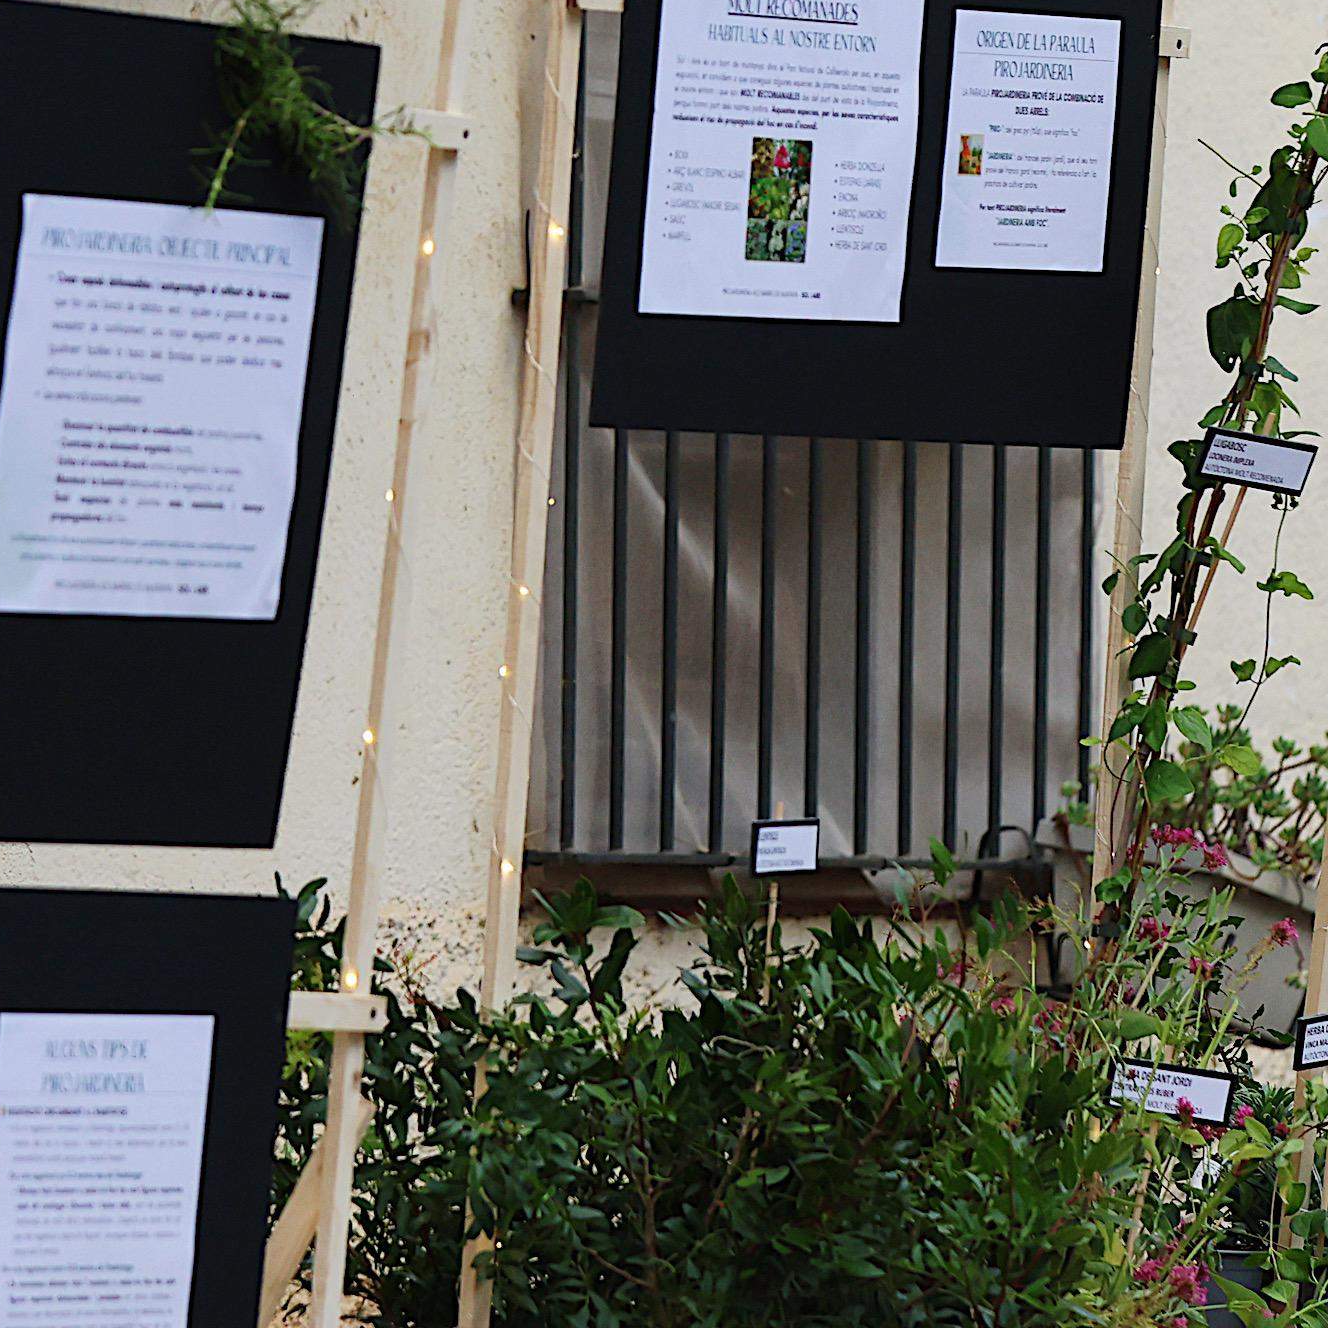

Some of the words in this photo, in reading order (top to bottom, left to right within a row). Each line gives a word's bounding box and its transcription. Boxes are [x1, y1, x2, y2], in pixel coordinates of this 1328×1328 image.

[707, 23, 768, 45] HABITUALS
[773, 29, 785, 46] AL
[790, 30, 831, 51] NOSTRE
[834, 33, 878, 53] ENTORN
[977, 30, 1014, 49] ORIGEN
[1017, 33, 1031, 50] DE
[1034, 34, 1046, 51] LA
[1049, 35, 1095, 54] PARAULA
[994, 60, 1073, 81] PIROJARDINERIA
